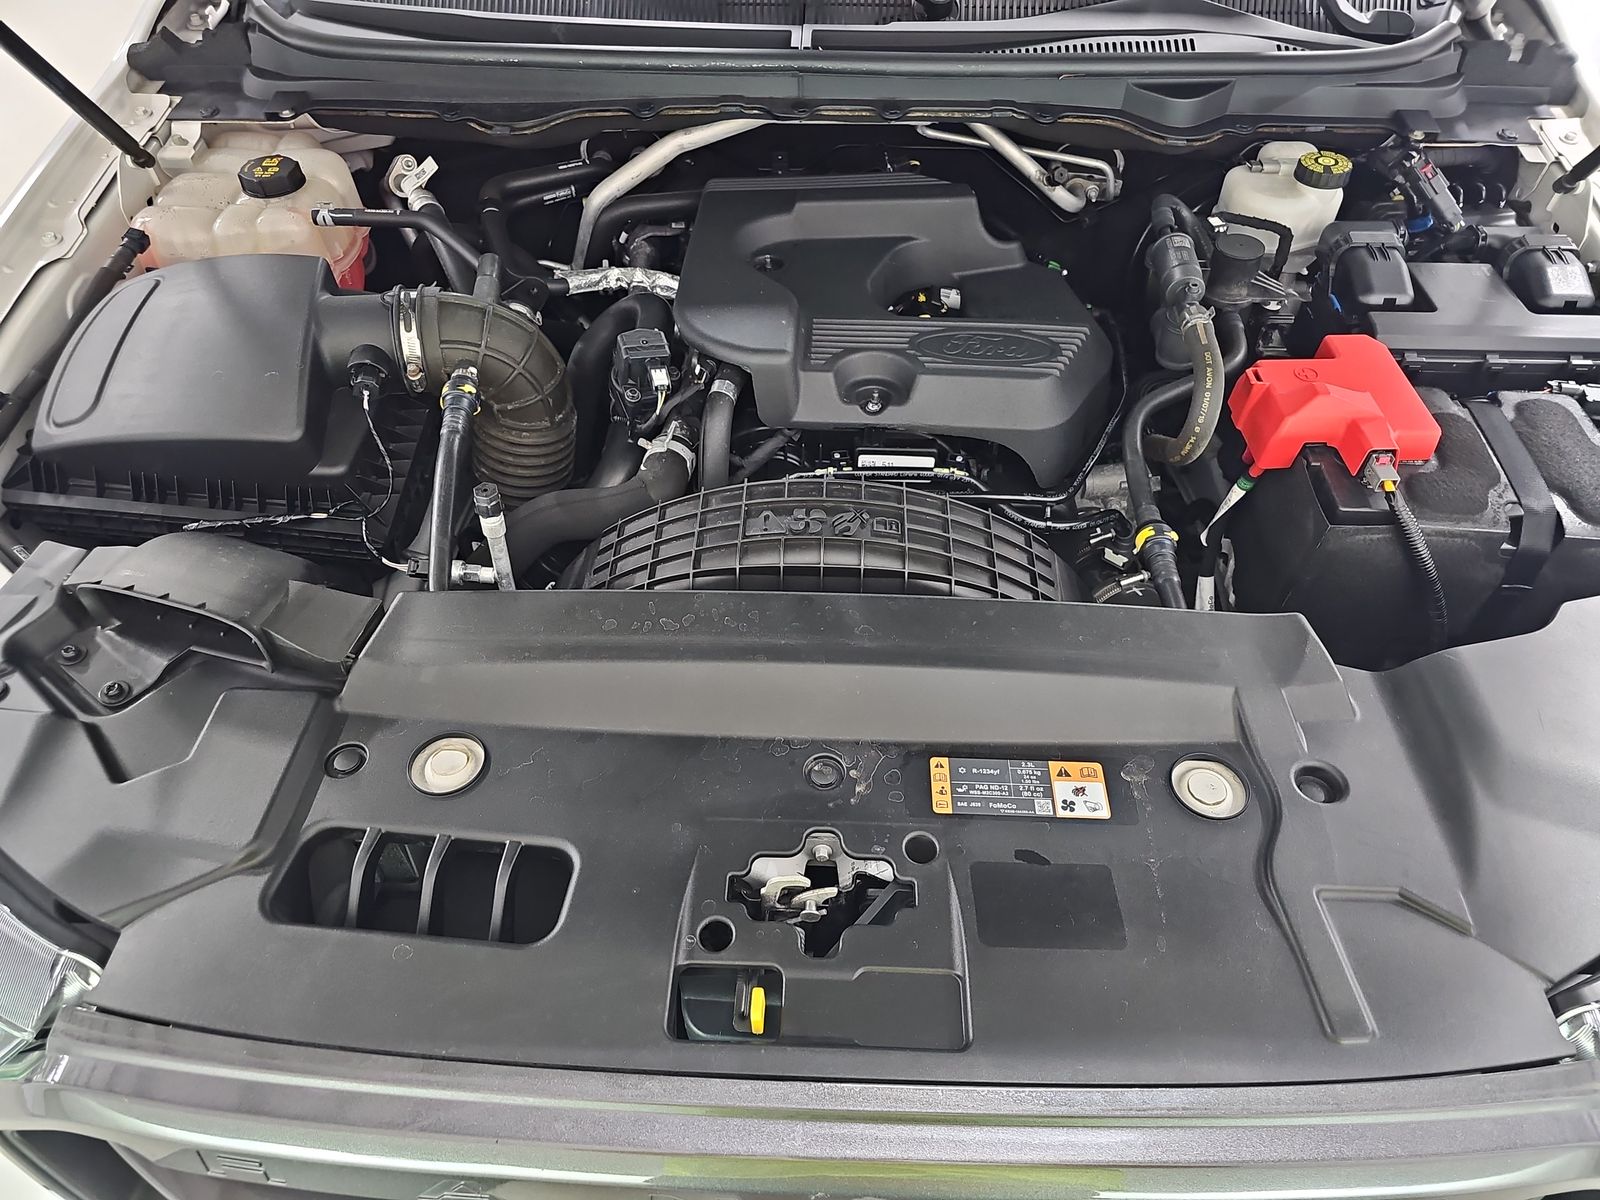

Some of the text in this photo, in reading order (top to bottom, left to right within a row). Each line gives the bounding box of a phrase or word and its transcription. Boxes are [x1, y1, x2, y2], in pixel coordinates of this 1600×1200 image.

[942, 334, 1029, 357] Ford
[1205, 367, 1213, 389] AVON
[1197, 391, 1211, 424] 01/07/19
[989, 802, 1017, 810] FoMoCo
